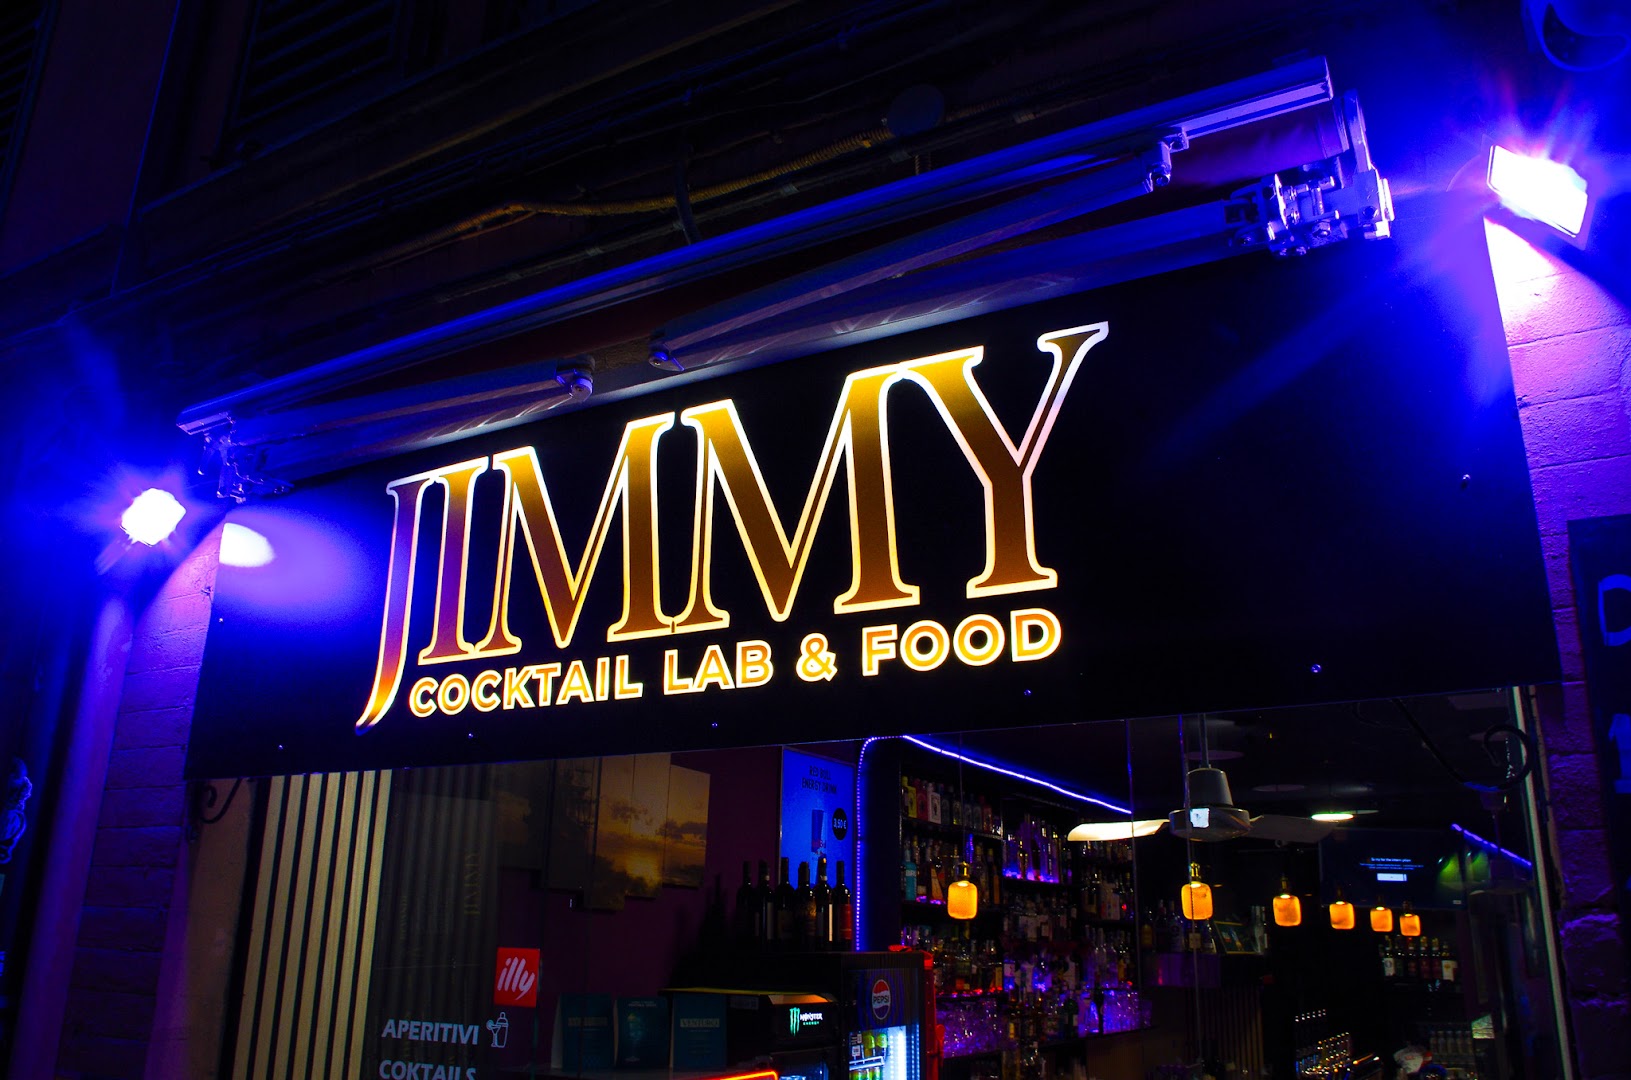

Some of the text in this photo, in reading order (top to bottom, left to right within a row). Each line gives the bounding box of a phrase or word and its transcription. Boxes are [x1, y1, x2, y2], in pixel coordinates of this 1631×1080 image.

[356, 321, 1109, 733] JIMMY
[408, 607, 1063, 718] COCKTAIL LAB & FOOD
[497, 956, 536, 1001] illy
[873, 994, 889, 1004] PEPSI
[381, 1018, 480, 1046] APERITIVI
